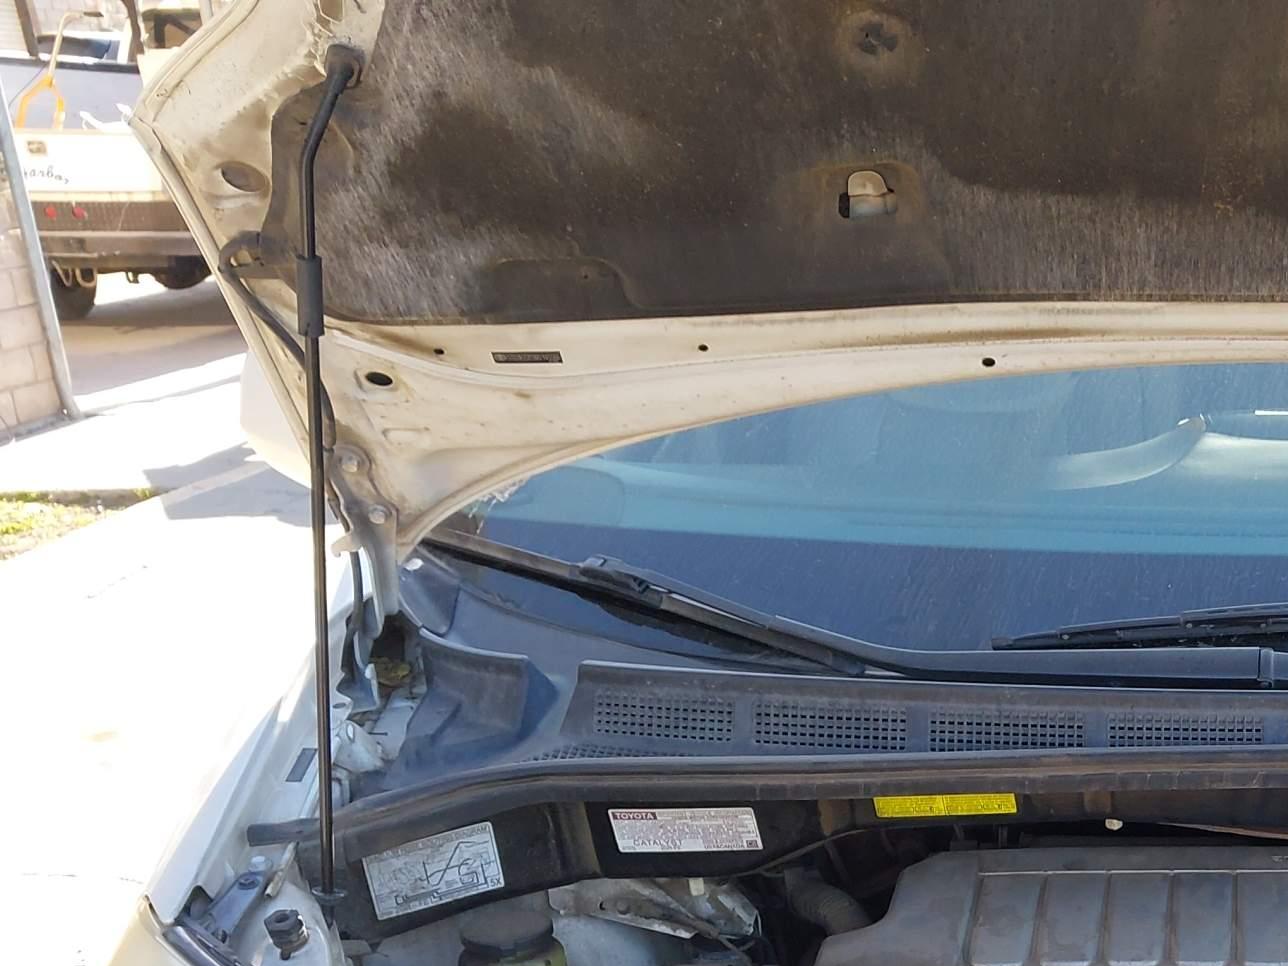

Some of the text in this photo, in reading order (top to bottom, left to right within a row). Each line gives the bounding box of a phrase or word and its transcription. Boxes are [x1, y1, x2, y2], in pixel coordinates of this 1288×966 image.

[615, 812, 655, 820] TOYOTA
[633, 839, 682, 847] CATALYST
[490, 877, 502, 888] 5X
